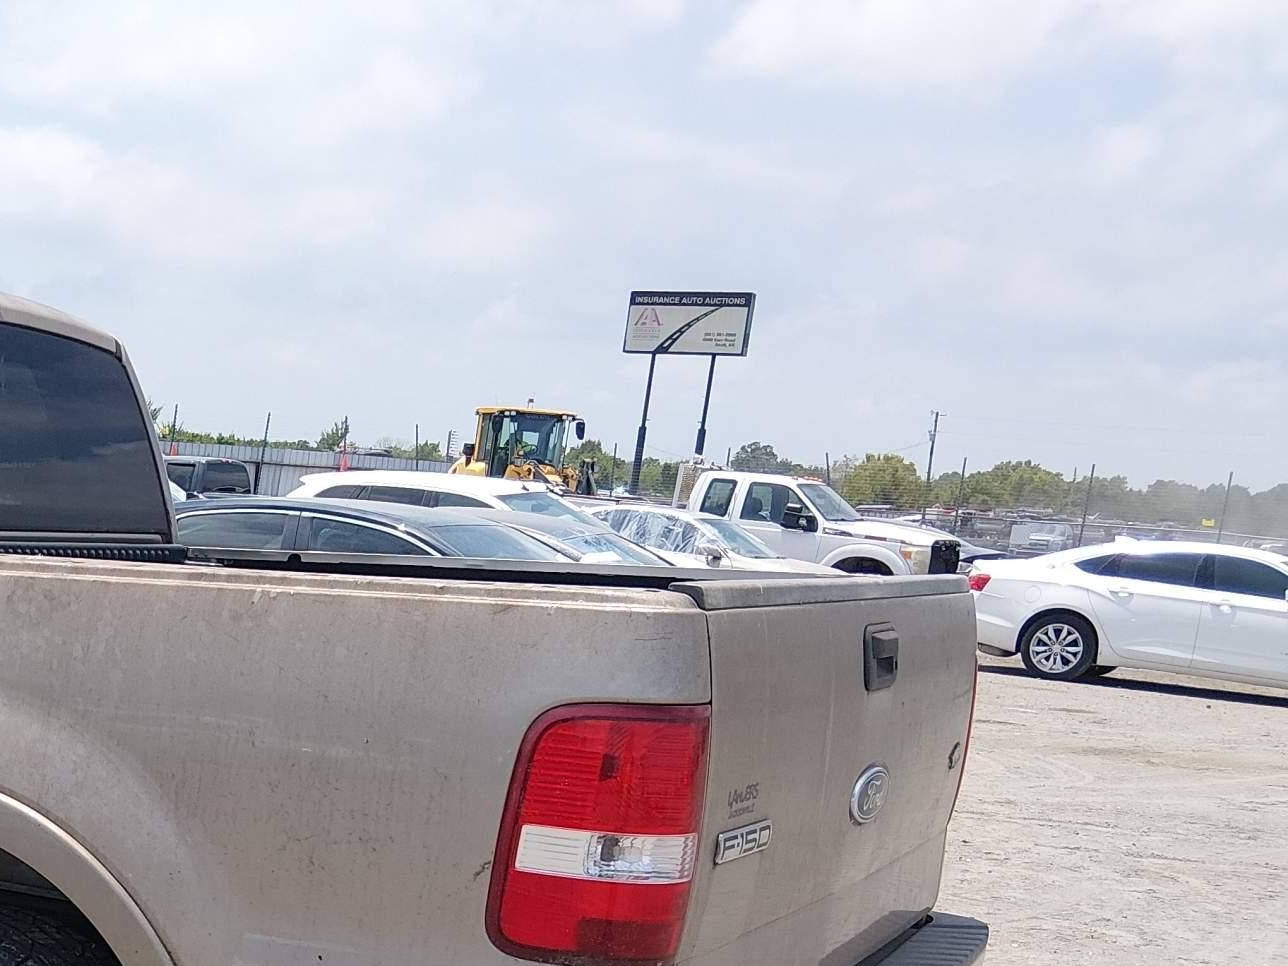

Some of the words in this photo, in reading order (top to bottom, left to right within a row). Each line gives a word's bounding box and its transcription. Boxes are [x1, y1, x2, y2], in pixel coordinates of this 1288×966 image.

[635, 295, 680, 304] INSURANCE
[681, 296, 703, 304] AUTO
[704, 296, 746, 305] AUCTIONS
